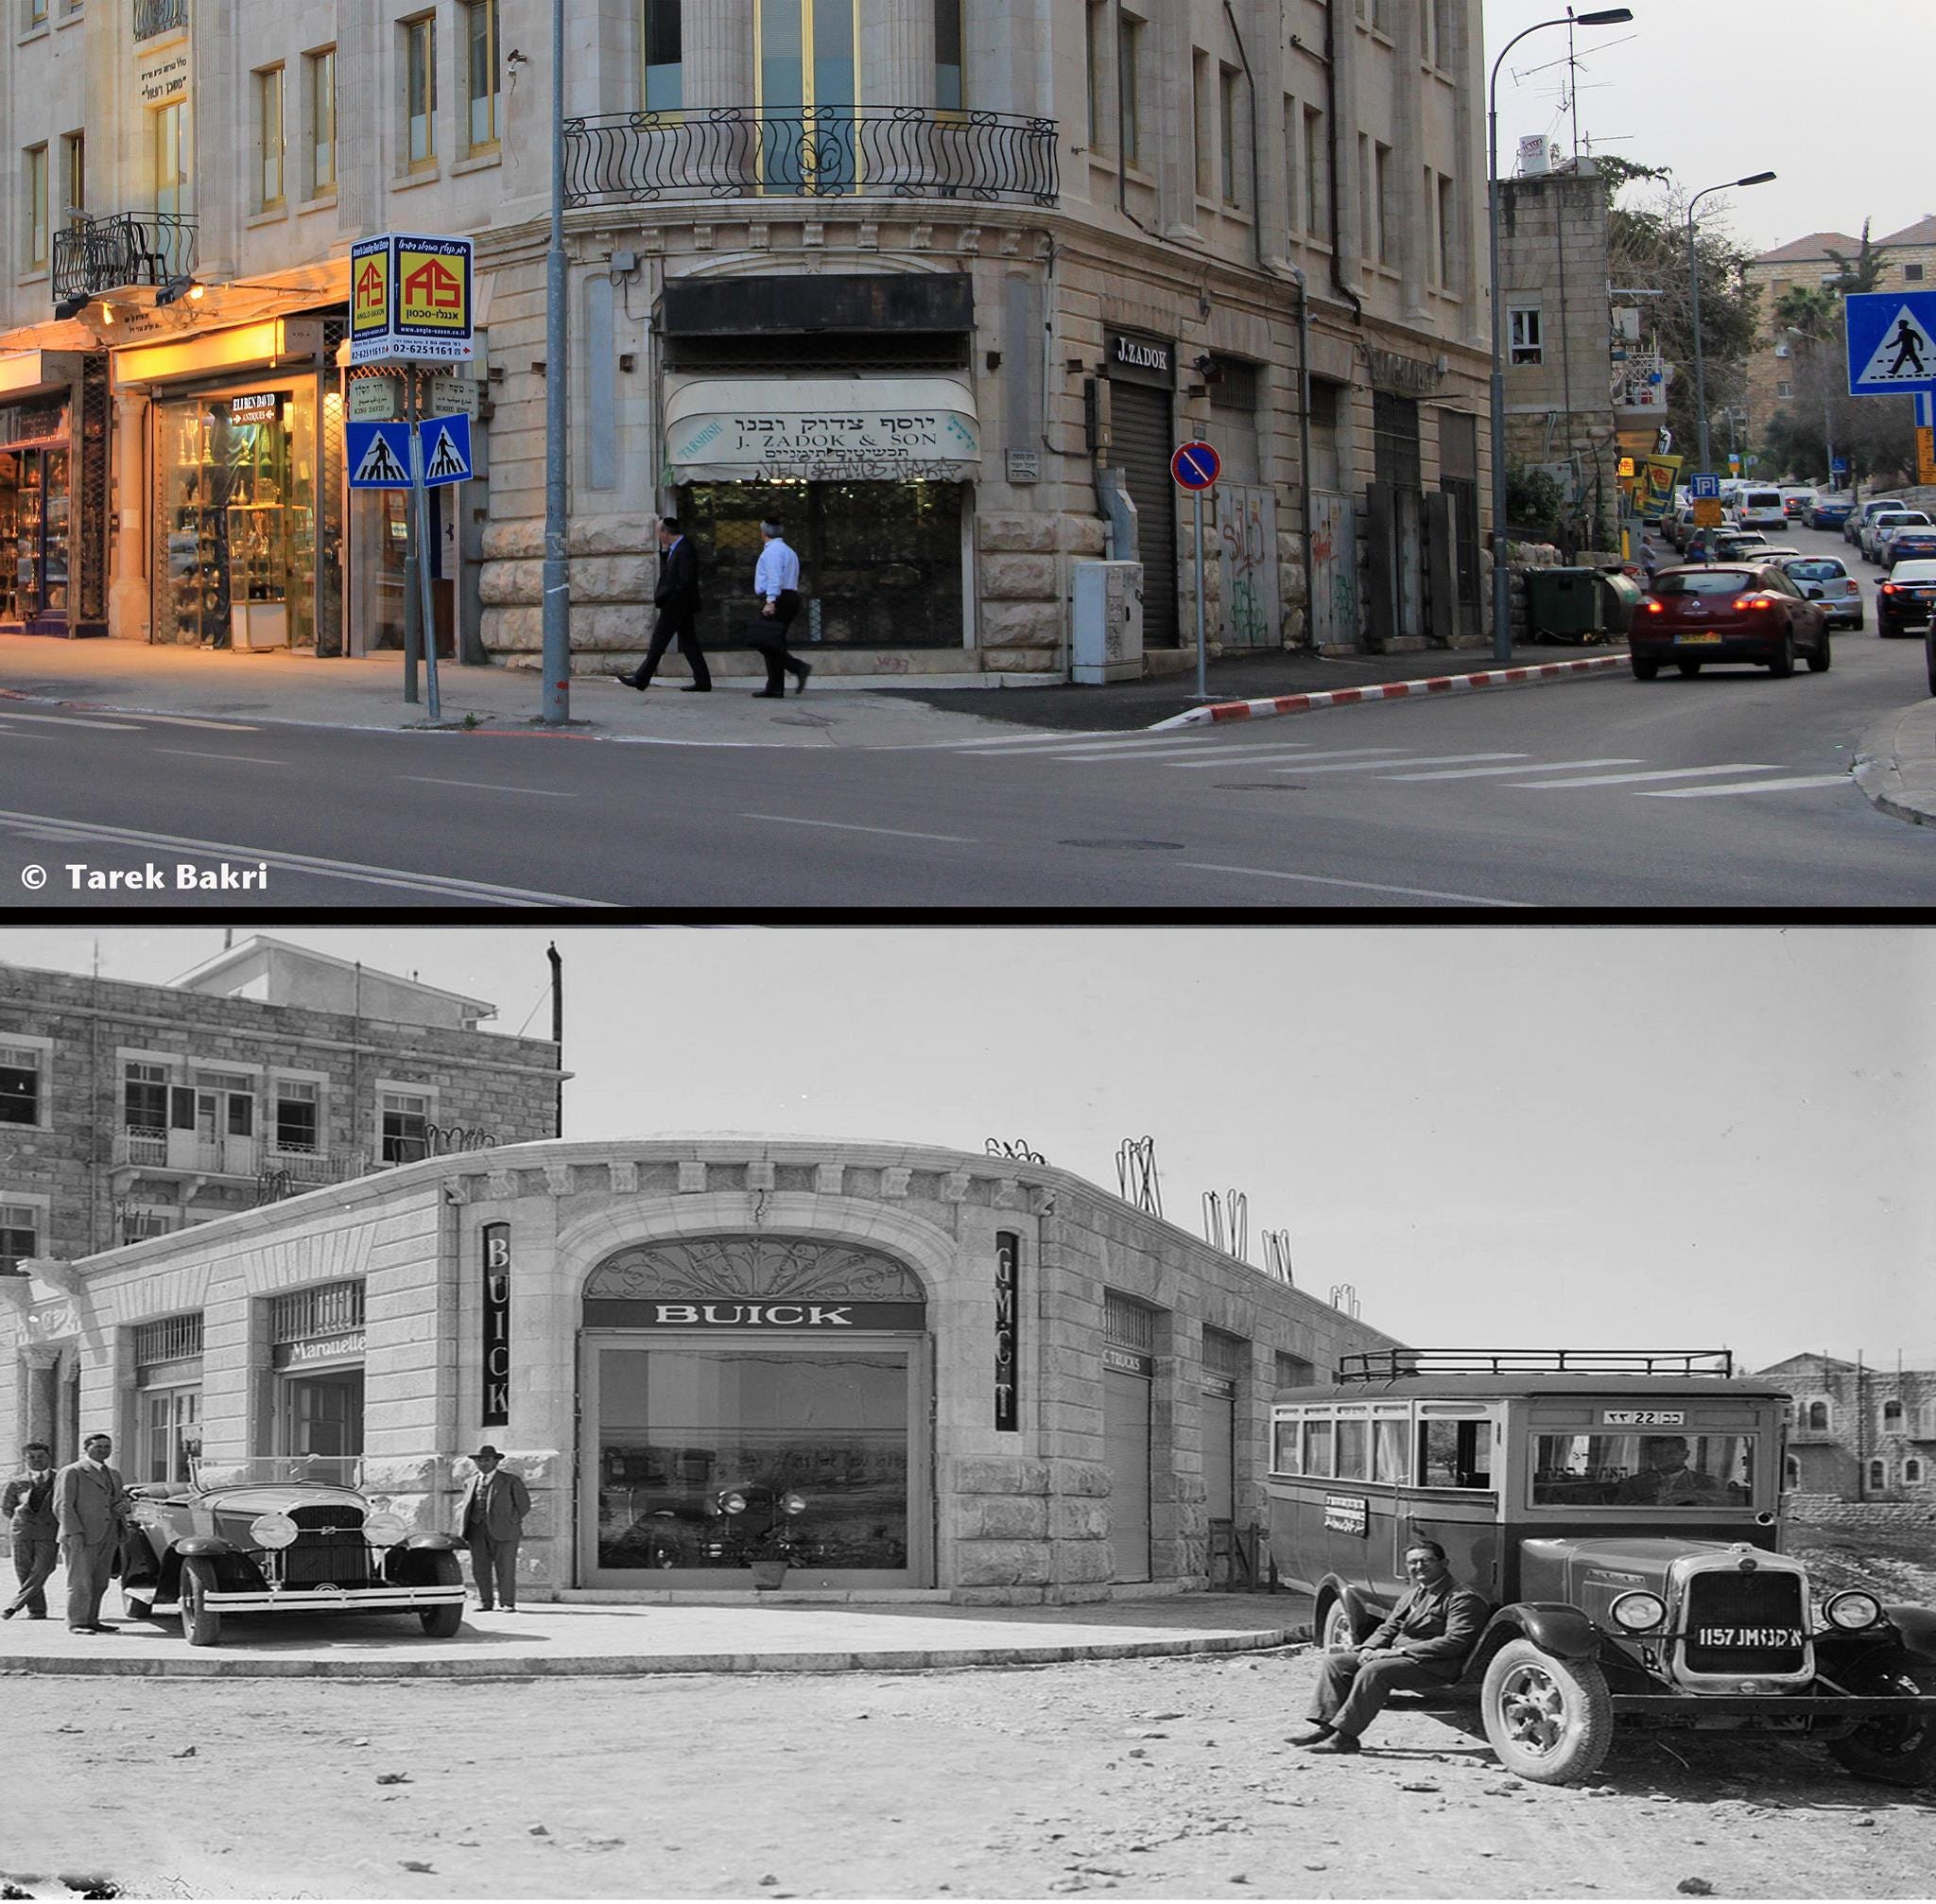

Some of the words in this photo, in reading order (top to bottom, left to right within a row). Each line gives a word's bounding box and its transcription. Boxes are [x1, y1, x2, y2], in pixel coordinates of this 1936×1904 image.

[406, 308, 459, 320] אנגלו-סכסון
[400, 326, 465, 336] www.anglo-saxon.co.il
[351, 346, 382, 360] 02-6251161
[393, 343, 453, 355] 02-6251161
[1118, 337, 1167, 371] J.ZADOK
[233, 398, 243, 411] ELI
[244, 396, 255, 409] BEN
[256, 393, 275, 407] DAVID
[242, 410, 266, 422] ANTIQUES
[735, 419, 786, 431] ובנו
[801, 419, 864, 434] צדוק
[880, 417, 935, 433] יוסף
[736, 436, 750, 450] J.
[763, 435, 845, 447] ZADOK
[858, 434, 877, 446] &
[890, 433, 937, 446] SON
[765, 448, 826, 459] תימניים
[655, 1305, 853, 1324] BUICK
[488, 1238, 510, 1414] BUICK
[291, 1333, 368, 1361] Marquette
[1110, 1350, 1141, 1371] TRUCKS
[1634, 1411, 1654, 1424] 22
